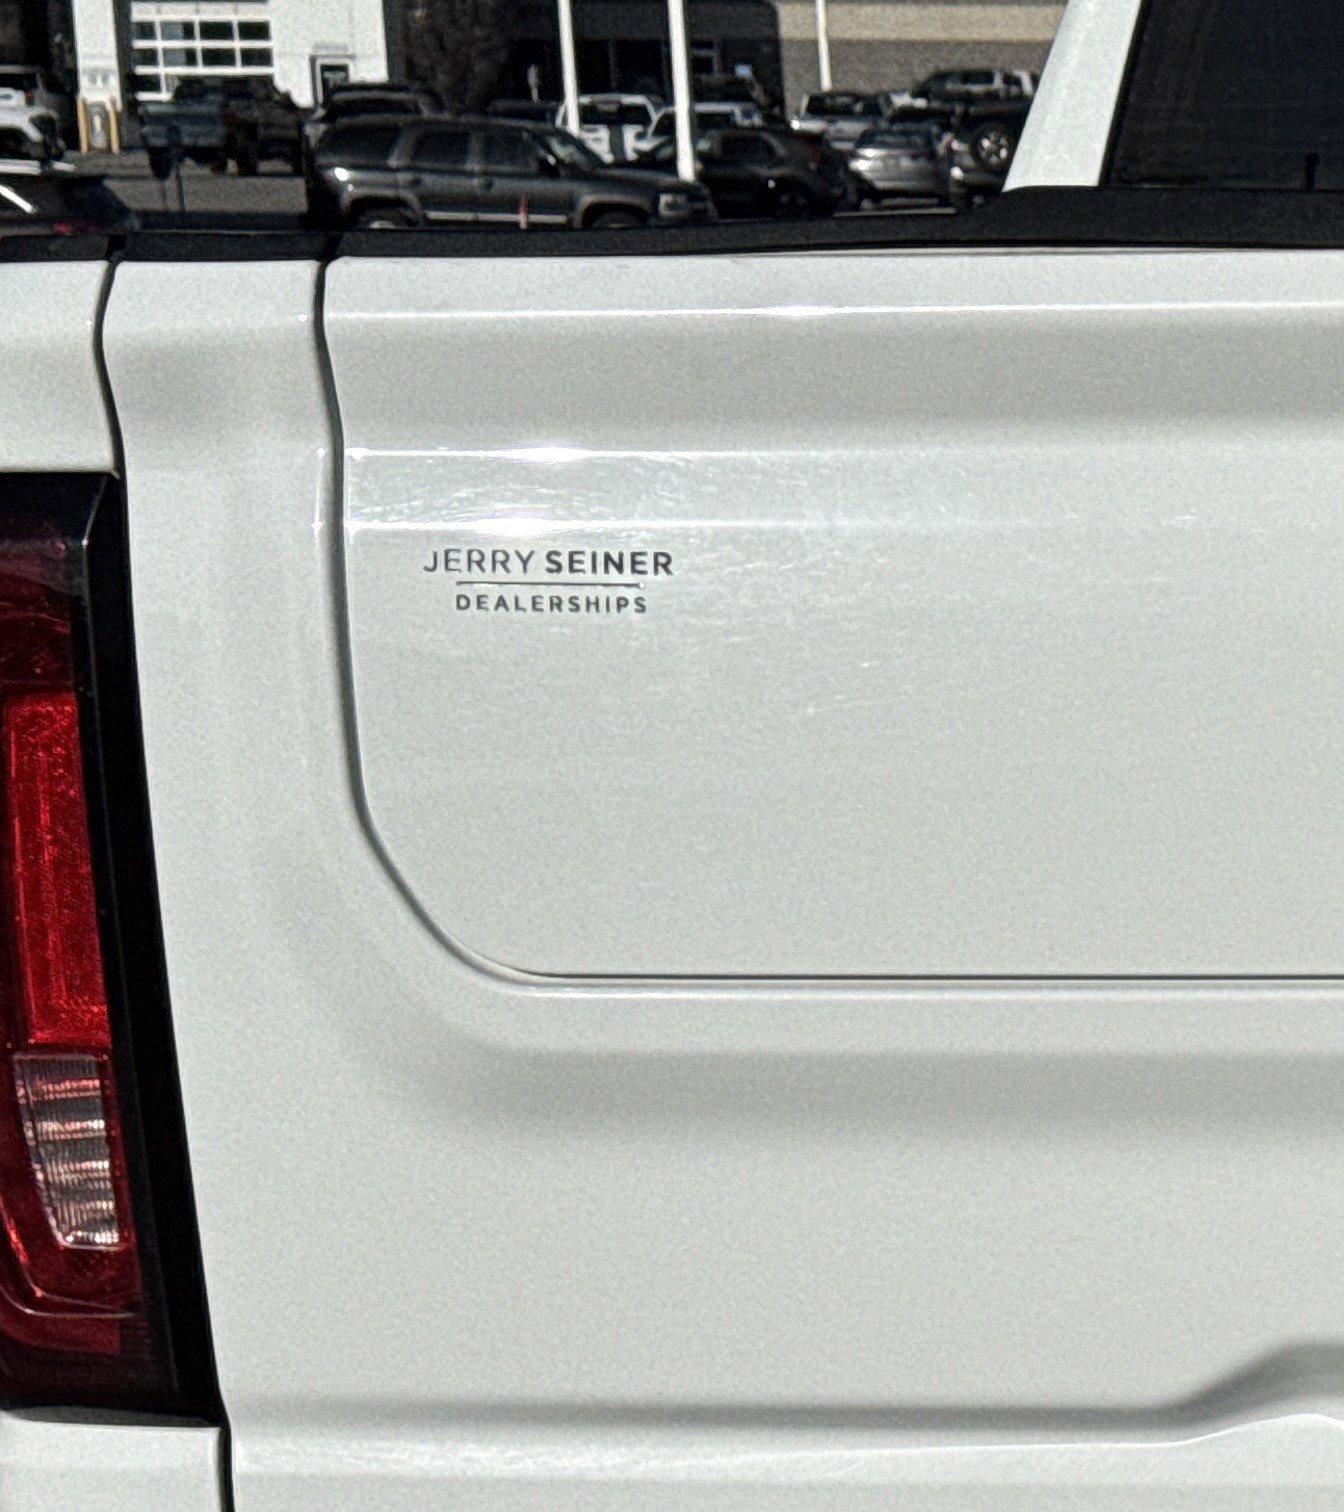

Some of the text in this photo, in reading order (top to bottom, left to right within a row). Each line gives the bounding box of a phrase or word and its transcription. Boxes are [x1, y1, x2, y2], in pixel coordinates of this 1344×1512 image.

[423, 549, 674, 576] JERRY SEINER
[456, 593, 647, 614] DEALERSHIPS
